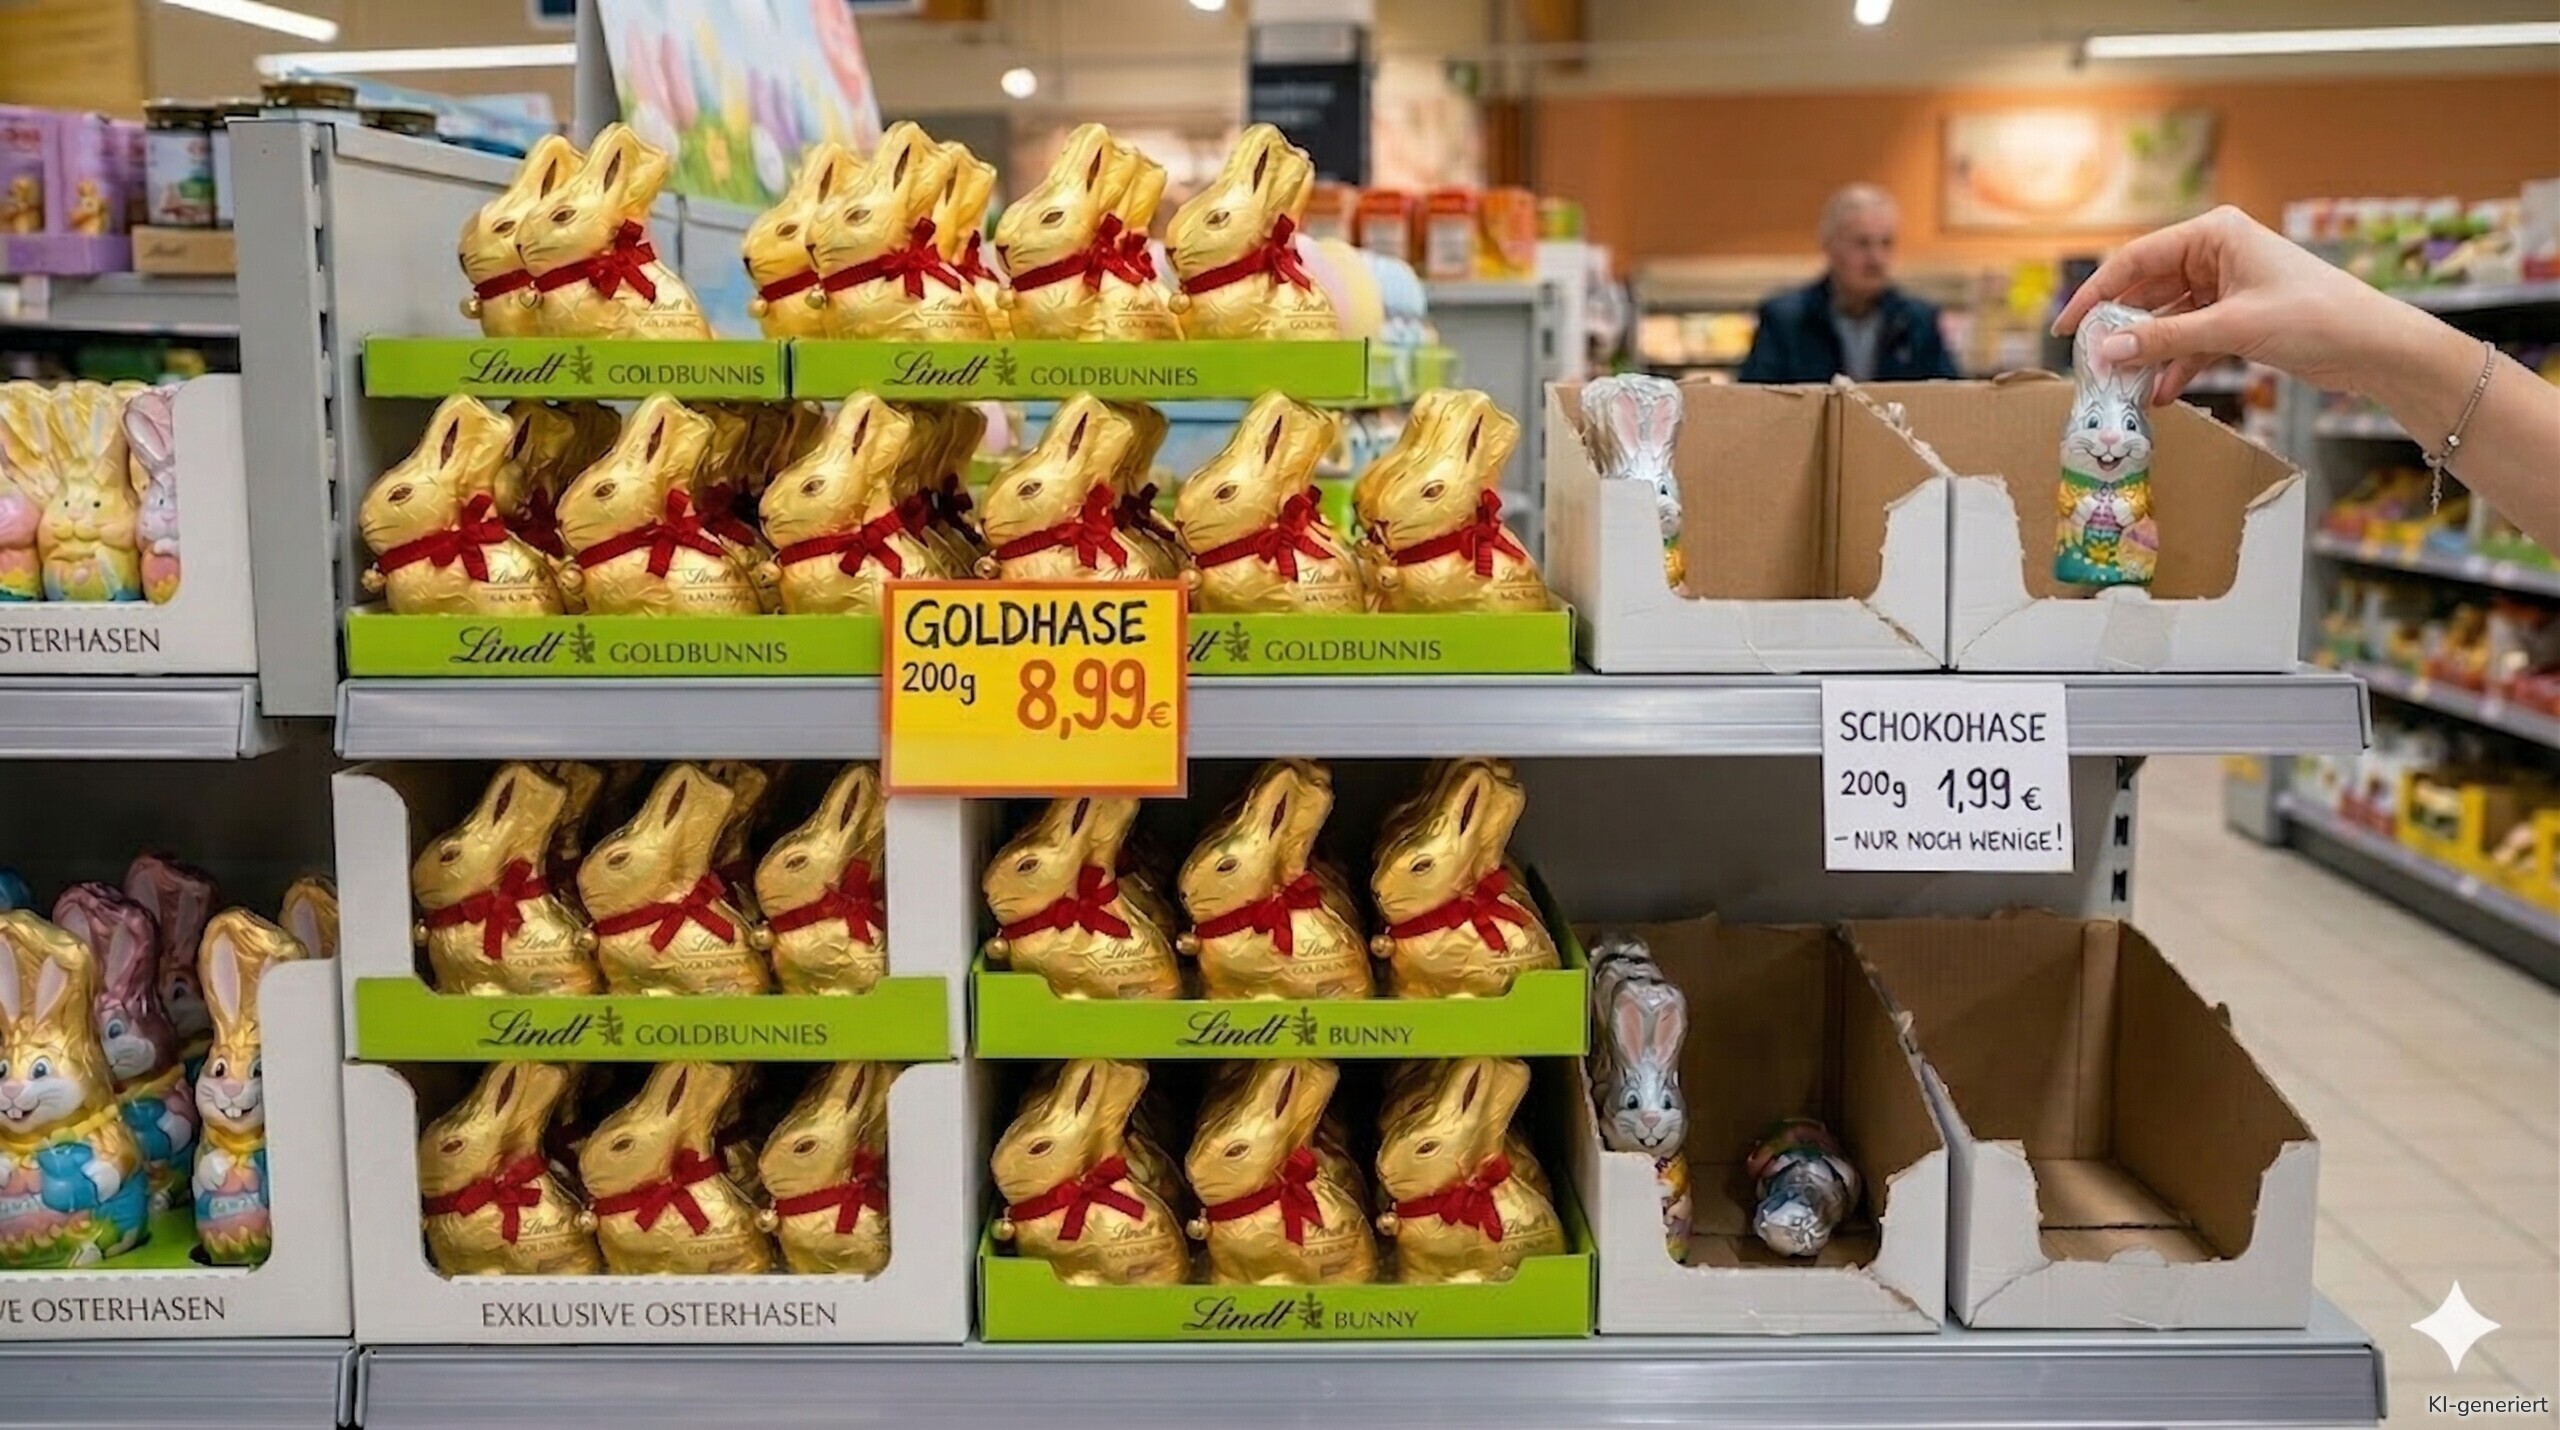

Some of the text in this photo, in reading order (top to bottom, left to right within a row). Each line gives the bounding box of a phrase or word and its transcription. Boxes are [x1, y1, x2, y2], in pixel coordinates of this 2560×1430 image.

[460, 349, 765, 385] Lindt GOLDBUNNIS
[884, 351, 1198, 387] Lindt GOLDBUNNIES
[905, 599, 1147, 648] GOLDHASE
[449, 626, 788, 664] Lindt GOLDBUNNIS
[1265, 640, 1441, 662] GOLDBUNNIS
[901, 661, 976, 706] 200g
[1840, 711, 2047, 743] SCHOKOHASE
[1841, 770, 1906, 808] 200g
[1855, 830, 1898, 850] NUR
[1908, 831, 1961, 851] NOCH
[477, 1009, 828, 1047] Lindt GOLDBUNNIES
[1177, 1010, 1413, 1046] Lindt BUNNY
[32, 1297, 226, 1323] OSTERHASEN
[481, 1302, 837, 1328] EXKLUSIVE OSTERHASEN
[1182, 1296, 1418, 1332] Lindt BUNNY
